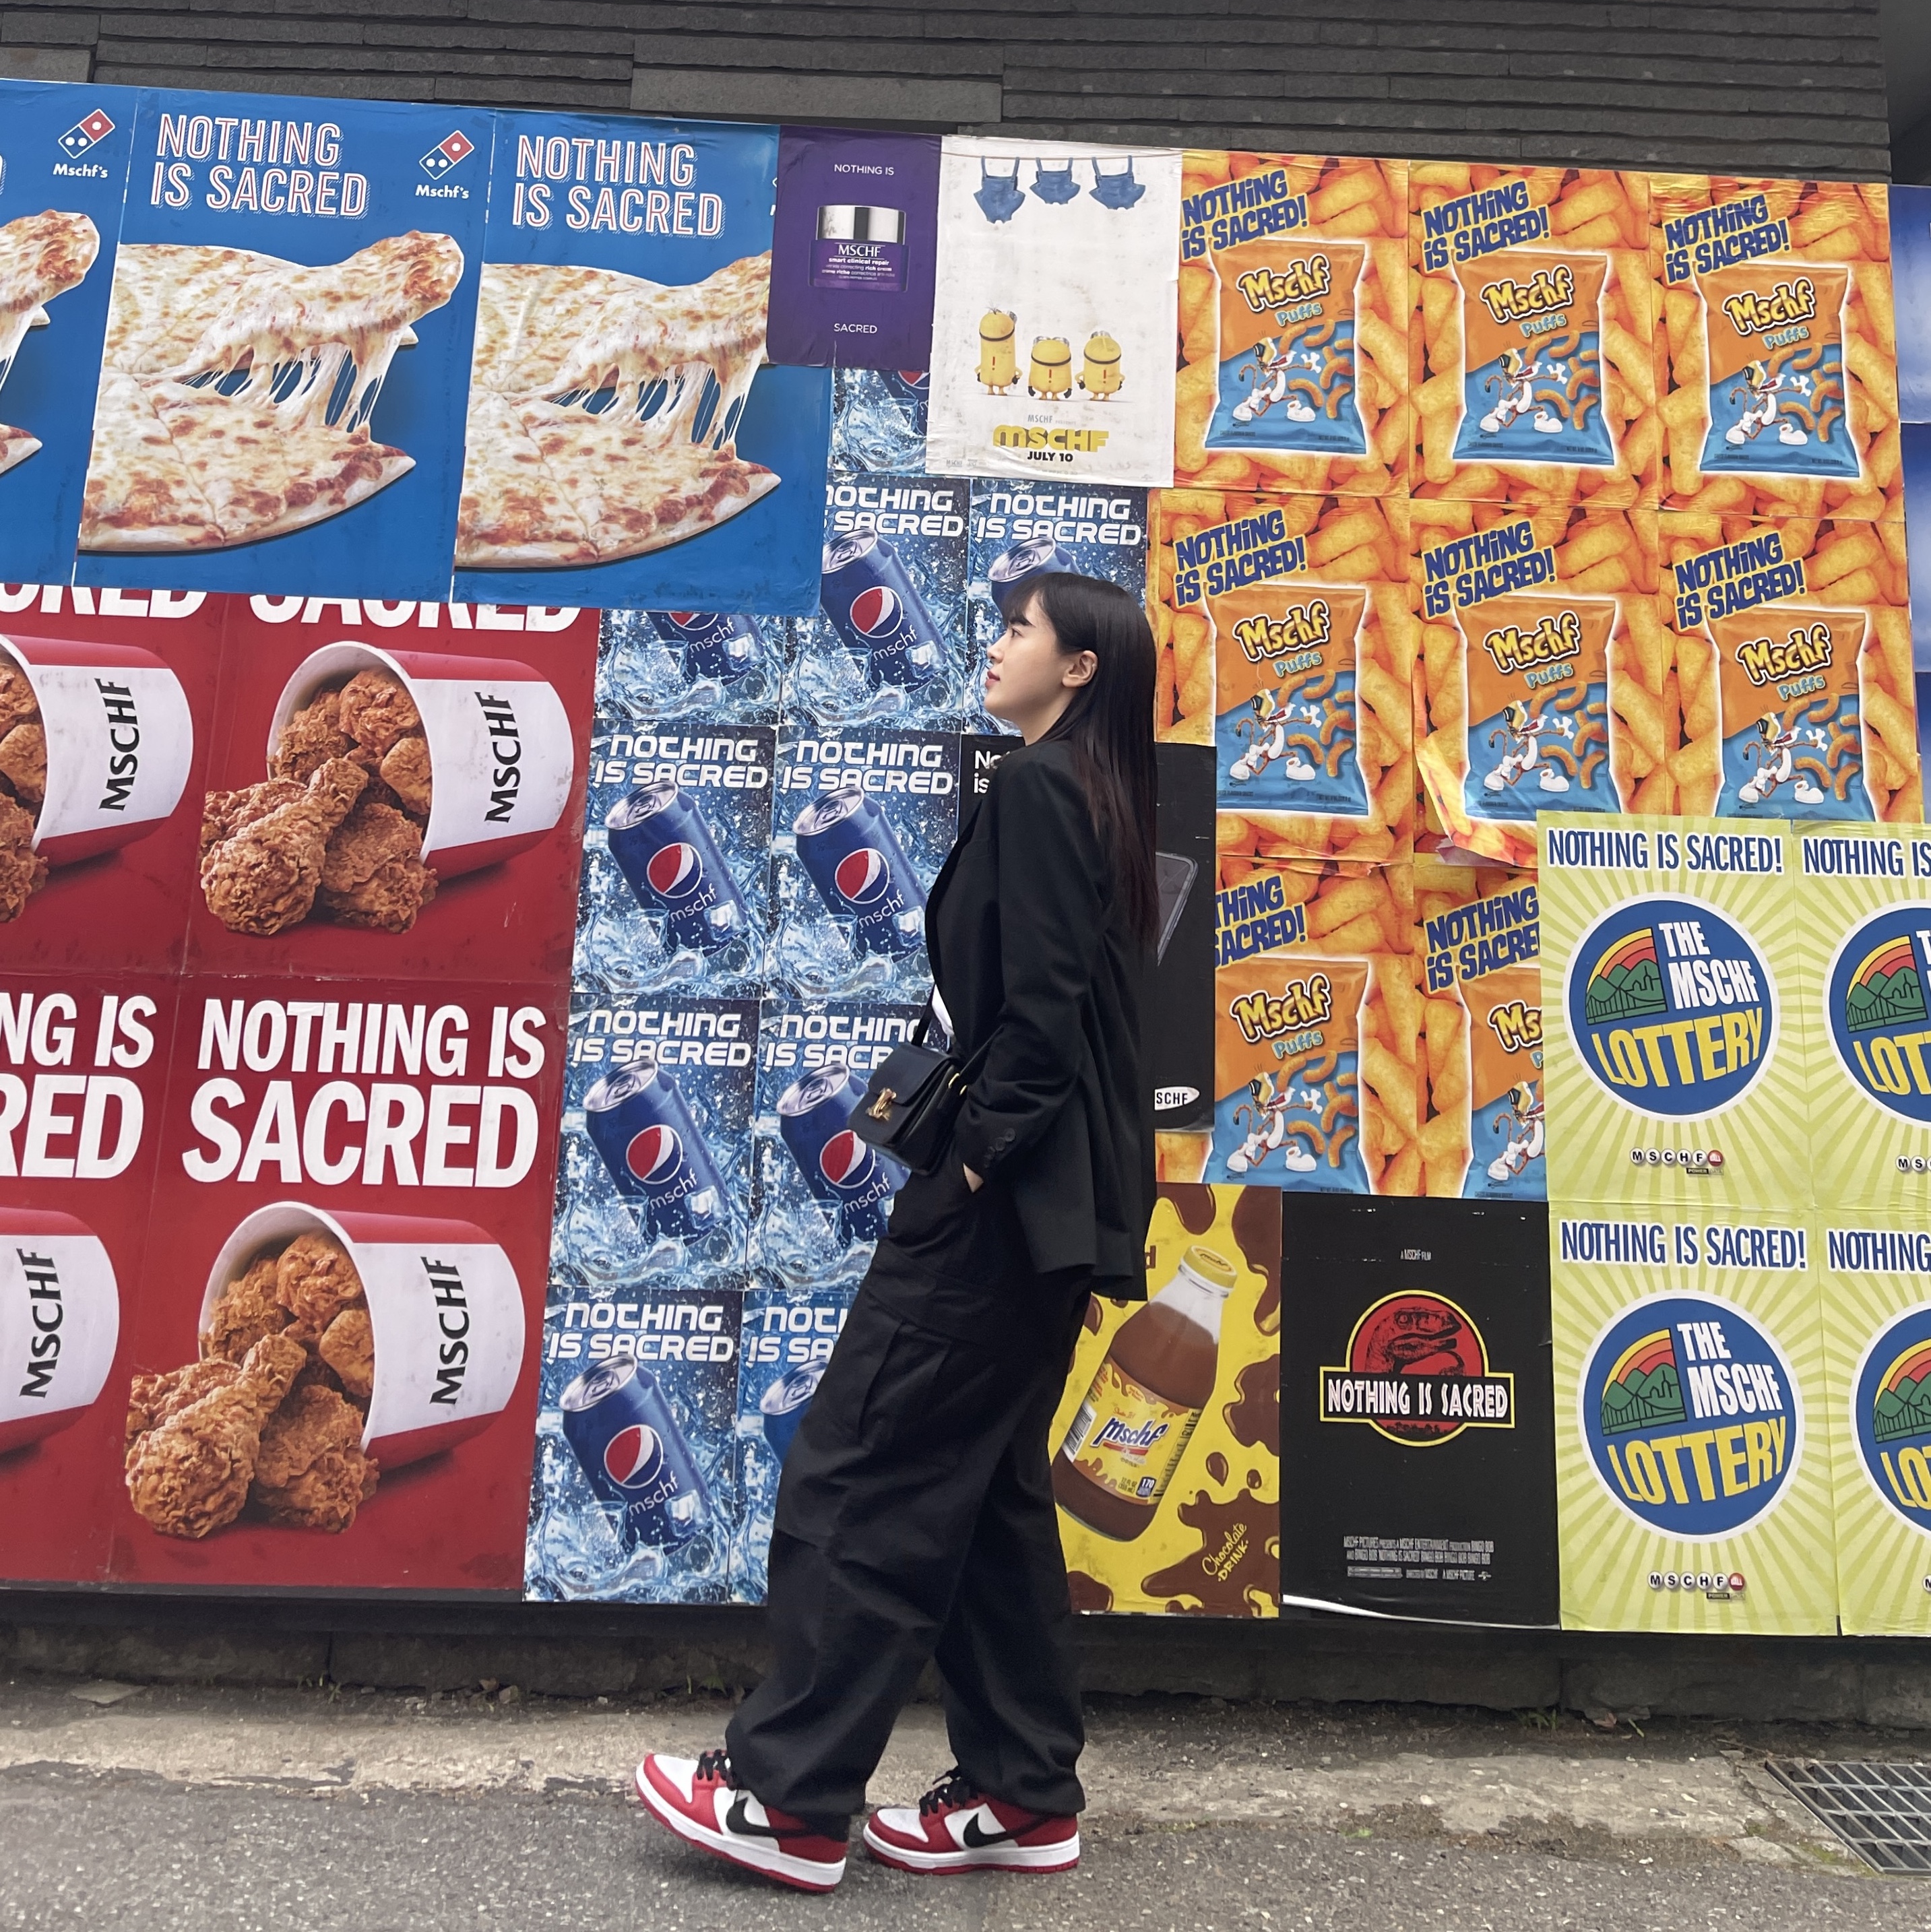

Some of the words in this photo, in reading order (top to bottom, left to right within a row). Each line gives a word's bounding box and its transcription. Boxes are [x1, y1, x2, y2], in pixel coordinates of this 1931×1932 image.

[156, 113, 344, 166] NOTHING
[53, 163, 108, 179] Mschf's
[515, 135, 697, 188] NOTHING
[834, 164, 883, 175] NOTHING
[885, 167, 895, 176] IS
[150, 162, 193, 208] IS
[206, 166, 369, 218] SACRED
[415, 184, 470, 199] Mschf's
[511, 183, 553, 228] IS
[566, 186, 724, 238] SACRED
[1212, 195, 1308, 251] SACRED!
[1456, 206, 1549, 261] SACRED!
[838, 244, 881, 257] MSCHF
[1697, 220, 1790, 273] SACRED!
[1240, 255, 1329, 309] Mschf
[1482, 266, 1573, 319] Mschf
[1276, 302, 1322, 326] Puffs
[1521, 313, 1566, 337] Puffs
[1724, 279, 1814, 332] Mschf
[833, 323, 878, 334] SACRED
[1763, 326, 1809, 350] Puffs
[1027, 414, 1053, 424] MSCHF
[1027, 451, 1056, 462] JULY
[1058, 452, 1073, 463] 10
[833, 510, 963, 537] SACRED
[990, 492, 1132, 521] NOTHING
[976, 517, 1007, 540] IS
[1011, 519, 1141, 546] SACRED
[1209, 537, 1306, 596] SACRED!
[1457, 548, 1555, 607] SACRED!
[1707, 560, 1806, 618] SACRED!
[688, 616, 736, 655] mschf
[873, 627, 918, 662] mschf
[1236, 600, 1329, 658] Mschf
[1486, 613, 1579, 670] Mschf
[1274, 651, 1321, 677] Puffs
[1739, 626, 1830, 682] Mschf
[1525, 663, 1573, 688] Puffs
[1778, 675, 1825, 701] Puffs
[94, 677, 140, 812] MSCHF
[474, 690, 522, 825] MSCHF
[609, 734, 759, 763] NOTHING
[796, 740, 943, 767] NOTHING
[594, 760, 629, 785] IS
[632, 762, 769, 790] SACRED
[782, 766, 813, 790] IS
[817, 767, 953, 795] SACRED
[974, 772, 990, 794] is
[1548, 829, 1648, 868] NOTHING
[1657, 834, 1679, 869] IS
[1686, 835, 1783, 873] SACRED!
[1804, 839, 1904, 876] NOTHING
[1911, 841, 1931, 876] IS
[670, 882, 718, 923] mschf
[858, 889, 906, 930] mschf
[1459, 921, 1540, 980] SACRE
[1658, 922, 1710, 957] THE
[1668, 959, 1761, 1010] MSCHF
[587, 1009, 742, 1039] NOTHING
[1234, 975, 1329, 1039] Mschf
[94, 995, 157, 1068] IS
[197, 998, 470, 1077] NOTHING
[488, 1006, 546, 1079] IS
[1273, 1030, 1323, 1058] Puffs
[1591, 1007, 1763, 1087] LOTTERY
[573, 1038, 605, 1063] IS
[610, 1039, 752, 1067] SACRED
[765, 1043, 798, 1067] IS
[182, 1077, 539, 1188] SACRED
[649, 1167, 699, 1211] mschf
[843, 1174, 892, 1215] mschf
[1561, 1221, 1666, 1264] NOTHING
[1676, 1225, 1699, 1264] IS
[1706, 1227, 1806, 1269] SACRED!
[1829, 1231, 1931, 1272] NOTHING
[16, 1247, 63, 1399] MSCHF
[420, 1256, 470, 1405] MSCHF
[565, 1302, 724, 1331] NOTHING
[549, 1332, 583, 1359] IS
[588, 1334, 734, 1362] SACRED
[748, 1336, 781, 1362] IS
[1677, 1321, 1732, 1361] THE
[1328, 1379, 1410, 1415] NOTHING
[1418, 1383, 1432, 1415] IS
[1441, 1382, 1509, 1419] SACRED
[1687, 1364, 1783, 1419] MSCHF
[1092, 1417, 1169, 1446] mschf
[1606, 1415, 1786, 1506] LOTTERY
[628, 1472, 679, 1517] mschf
[1141, 1479, 1155, 1489] 170
[1202, 1523, 1247, 1576] Chocolate
